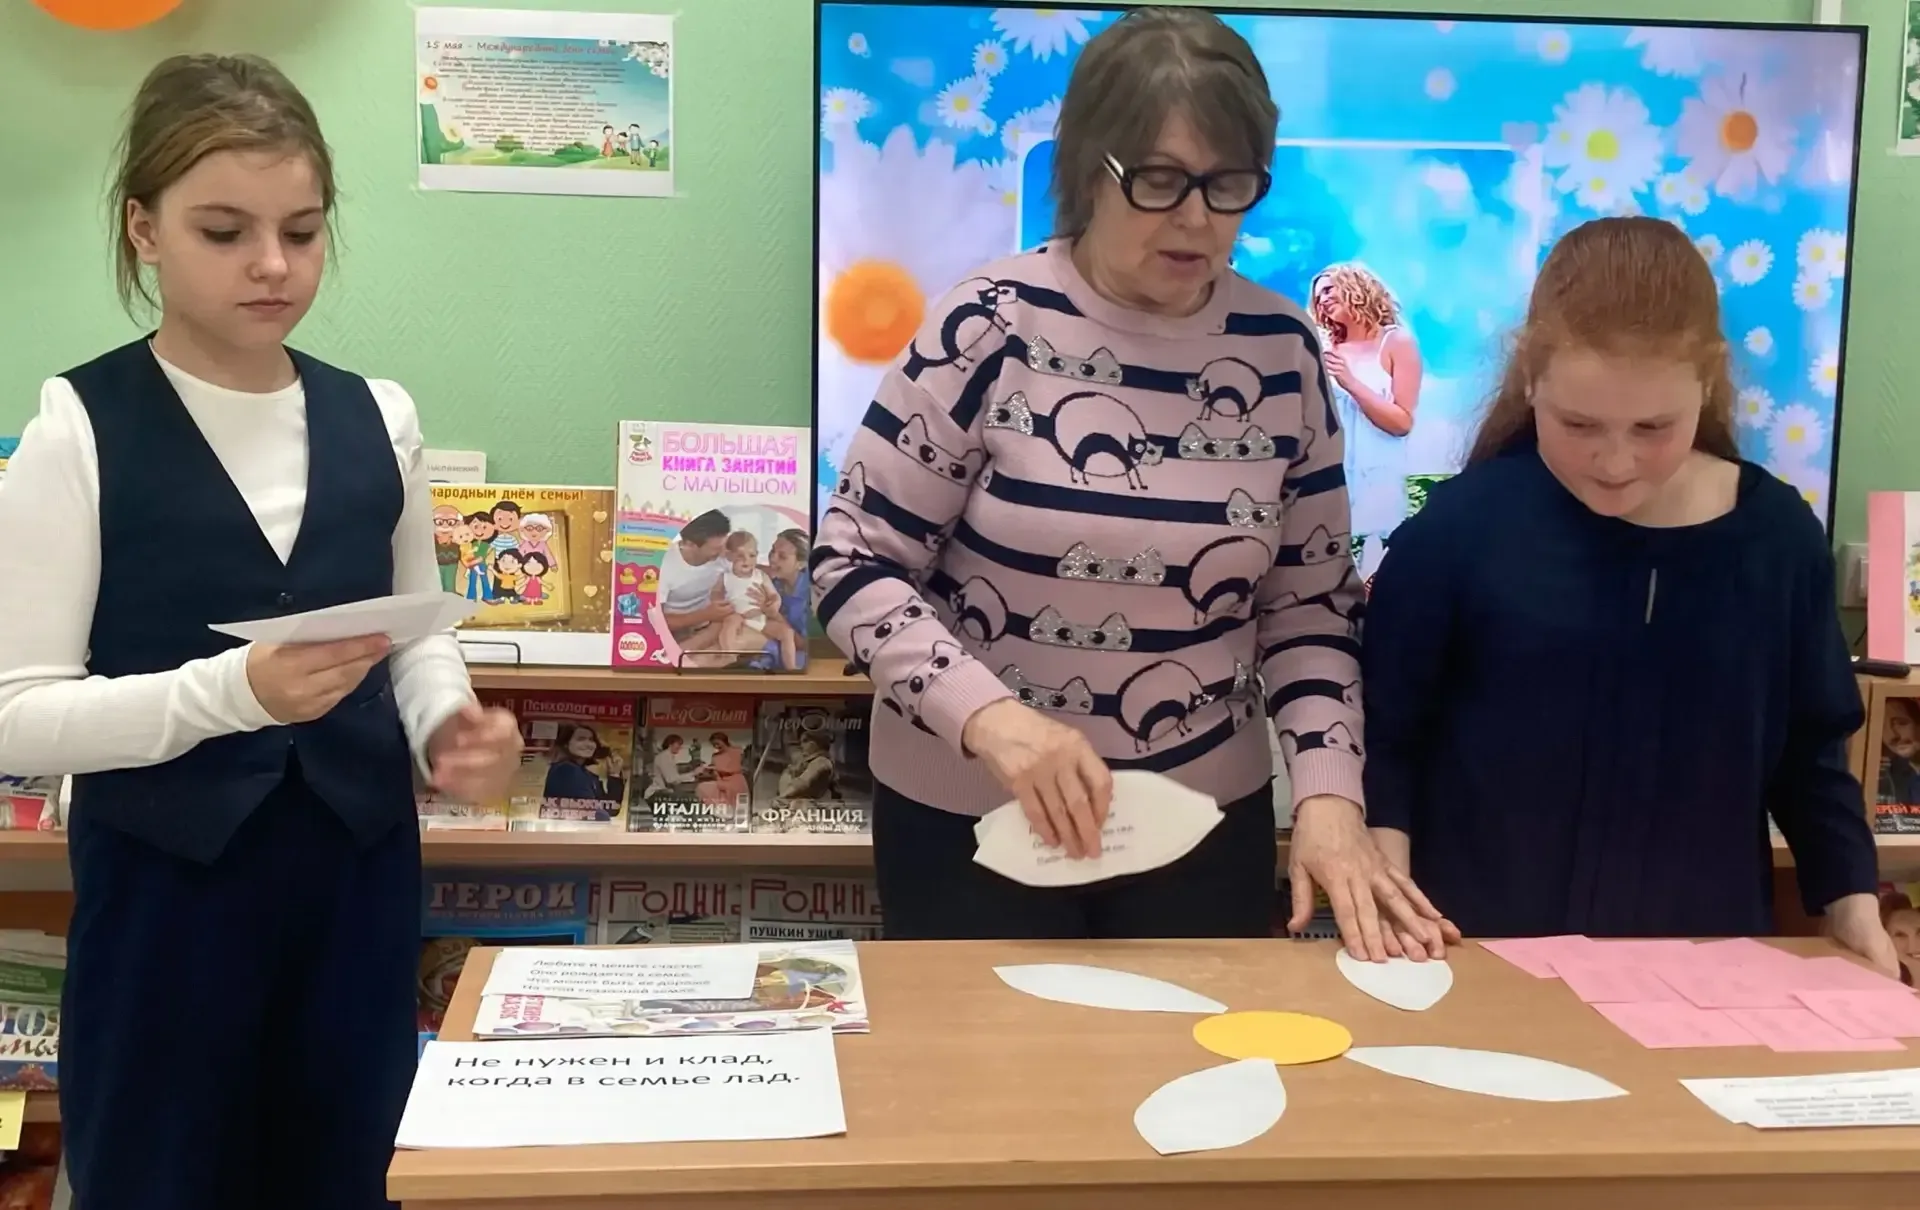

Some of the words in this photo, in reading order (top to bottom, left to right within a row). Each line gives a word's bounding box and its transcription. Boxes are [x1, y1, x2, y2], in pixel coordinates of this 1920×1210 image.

[426, 40, 439, 49] 15
[444, 41, 463, 50] мая
[662, 431, 797, 457] БОЛЬШАЯ
[662, 456, 716, 472] КНИГА
[722, 457, 797, 475] ЗАНЯТИЙ
[663, 475, 676, 491] С
[684, 475, 797, 495] МАЛЫШОМ
[502, 488, 535, 500] днём
[541, 489, 585, 501] семьи!
[523, 699, 605, 715] Психология
[609, 706, 618, 716] и
[622, 704, 632, 716] Я
[653, 802, 727, 816] ИТАЛИЯ
[761, 807, 864, 825] ФРАНЦИЯ
[429, 881, 577, 910] ГЕРОИ
[750, 925, 804, 938] ПУШКИН
[454, 1057, 501, 1068] Не
[515, 1058, 630, 1069] нужен
[645, 1057, 665, 1066] и
[678, 1054, 774, 1066] клад,
[448, 1076, 552, 1088] когда
[567, 1077, 585, 1085] в
[598, 1075, 711, 1086] семье
[723, 1073, 801, 1085] лад.
